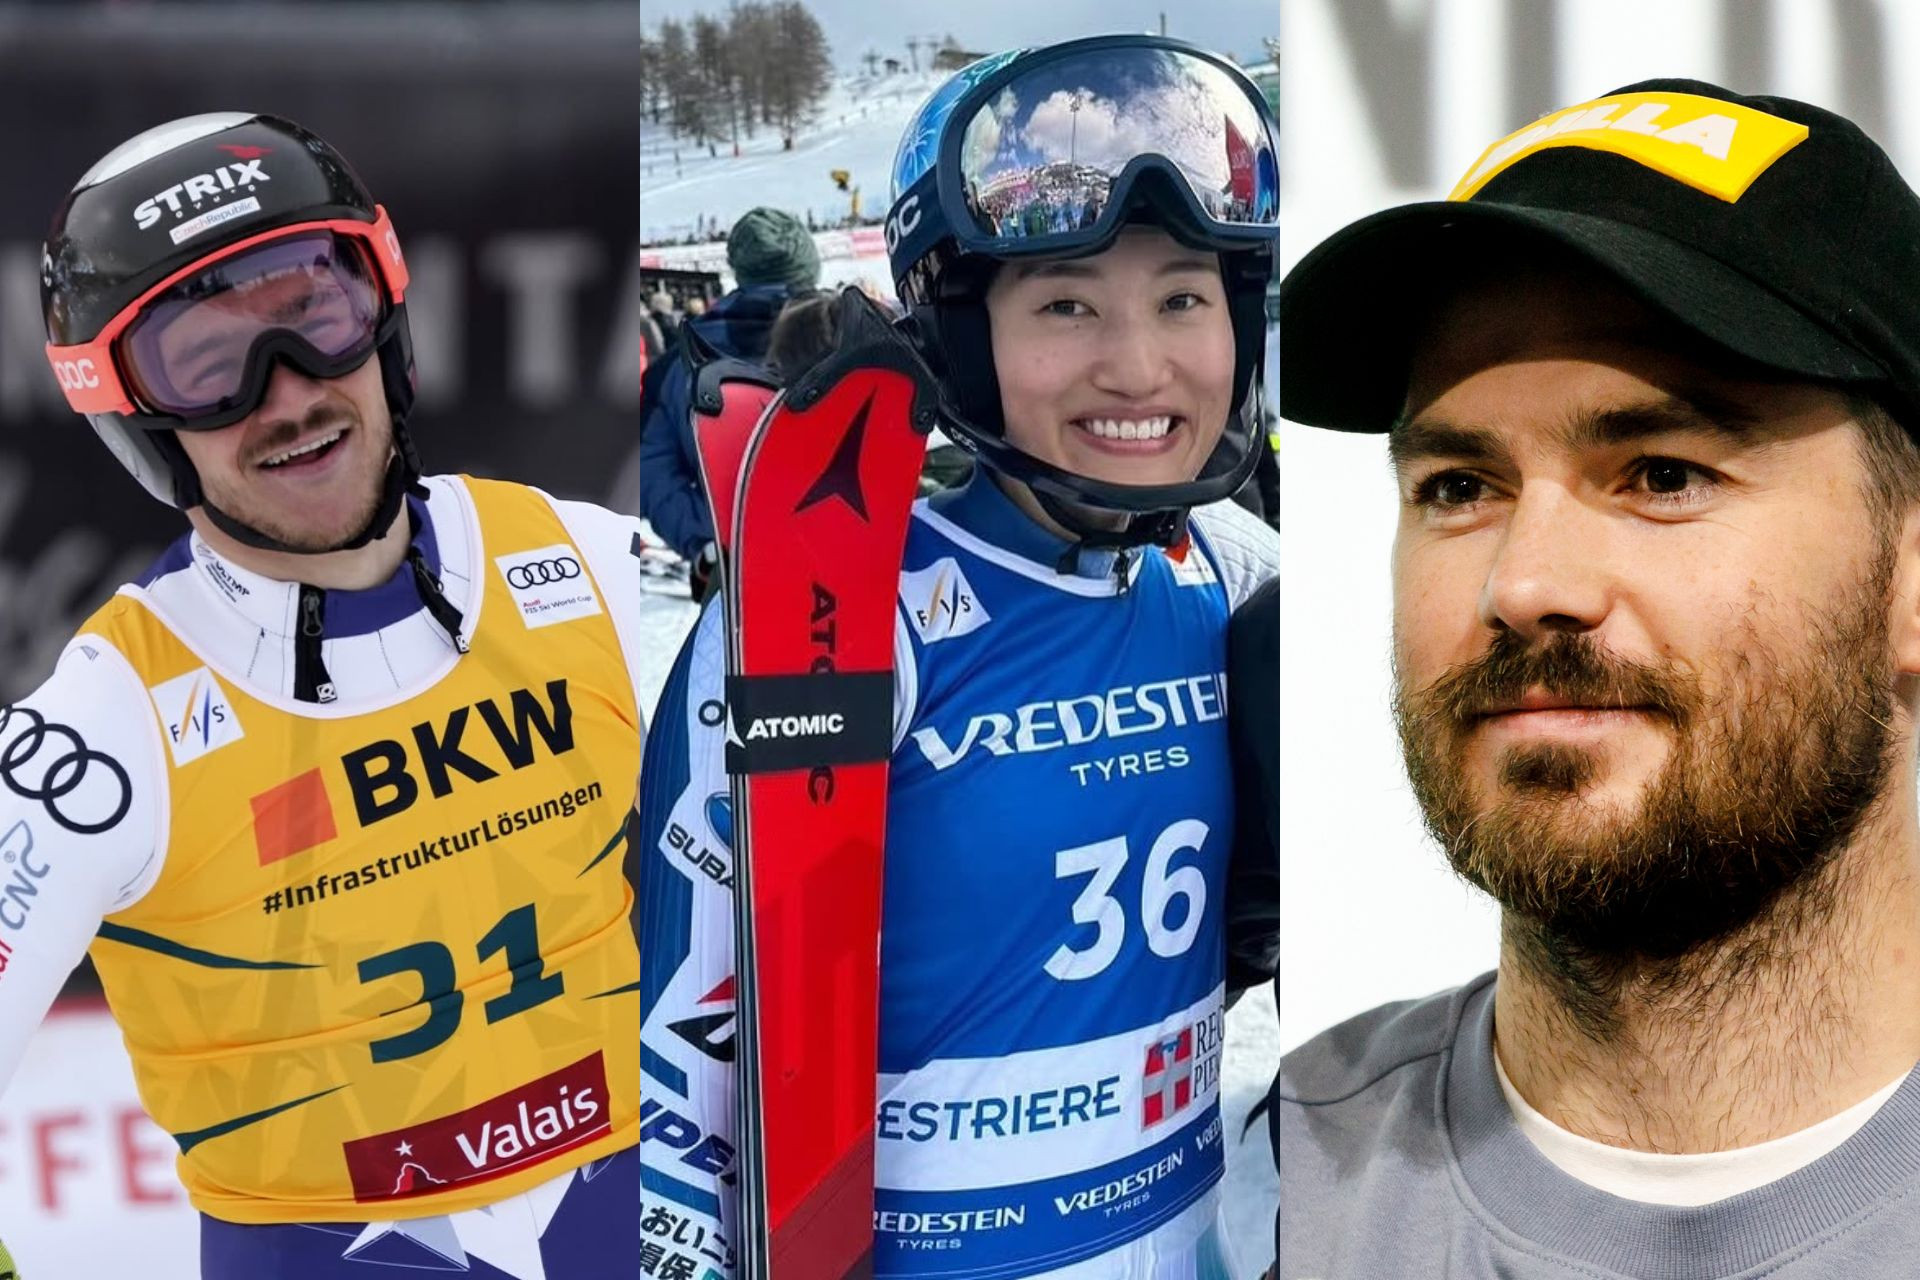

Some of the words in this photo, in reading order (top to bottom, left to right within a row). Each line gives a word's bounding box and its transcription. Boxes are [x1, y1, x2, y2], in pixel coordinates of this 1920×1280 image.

[134, 159, 271, 230] STRIX
[886, 194, 921, 255] OC
[341, 679, 574, 828] BKW
[746, 714, 844, 740] ATOMIC
[911, 672, 1227, 770] VREDESTEI
[1070, 746, 1189, 786] TYRES
[263, 781, 602, 914] #InfrastrukturLösungen
[1043, 819, 1210, 980] 36
[358, 903, 564, 1063] 31
[455, 1085, 598, 1168] Valais
[877, 1075, 1120, 1141] ESTRIERE
[1054, 1147, 1183, 1215] VREDESTEIN
[1104, 1192, 1150, 1218] TYRES
[872, 1204, 1025, 1233] REDESTEIN
[897, 1238, 961, 1250] TYRES
